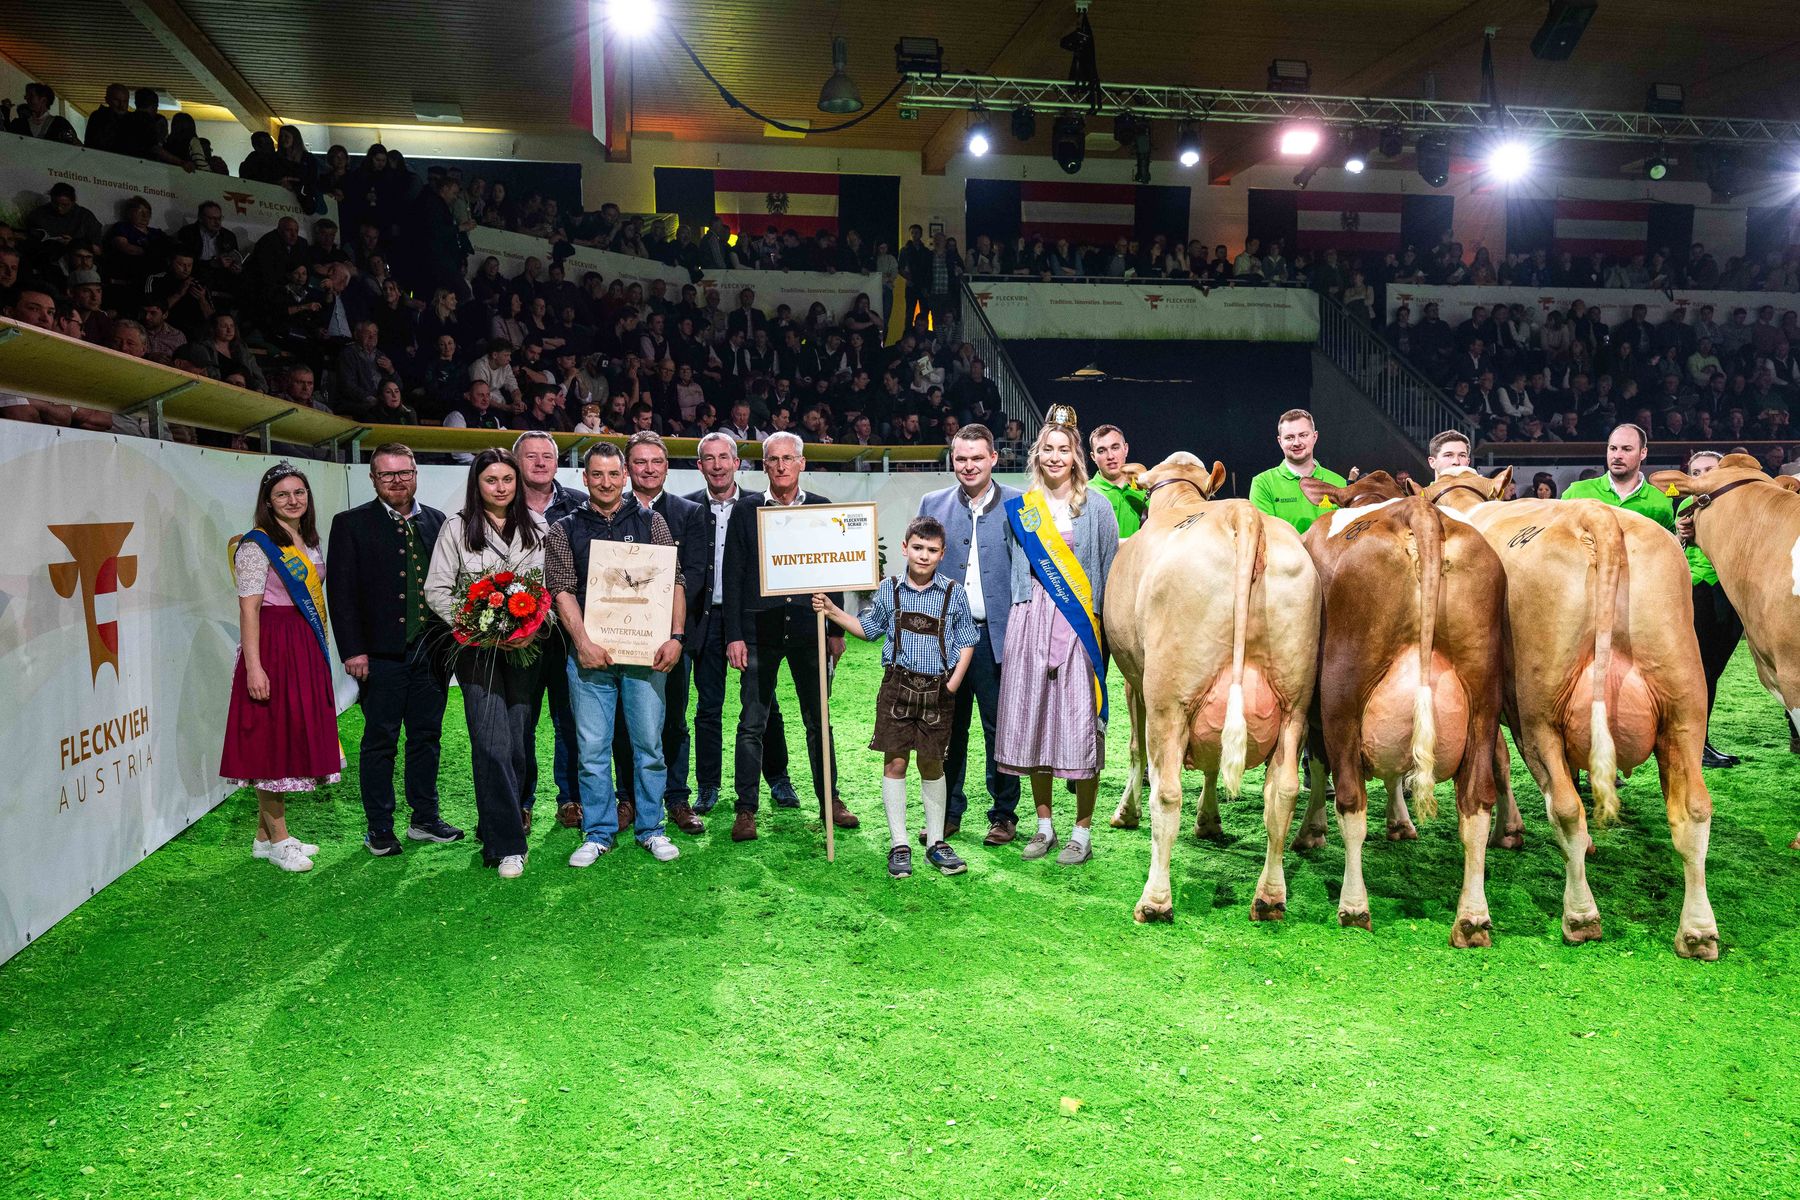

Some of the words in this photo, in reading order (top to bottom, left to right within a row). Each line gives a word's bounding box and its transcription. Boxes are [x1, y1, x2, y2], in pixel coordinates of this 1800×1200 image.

[48, 168, 91, 183] Tradition.
[93, 176, 141, 192] Innovation.
[143, 185, 178, 199] Emotion.
[628, 545, 640, 555] 12
[772, 550, 866, 567] WINTERTRAUM
[1038, 558, 1070, 604] Milchkönigin
[624, 615, 632, 625] 6
[600, 627, 653, 638] WINTERTRAUM
[60, 705, 149, 771] FLECKVIEH
[59, 744, 153, 814] AUSTRIA
